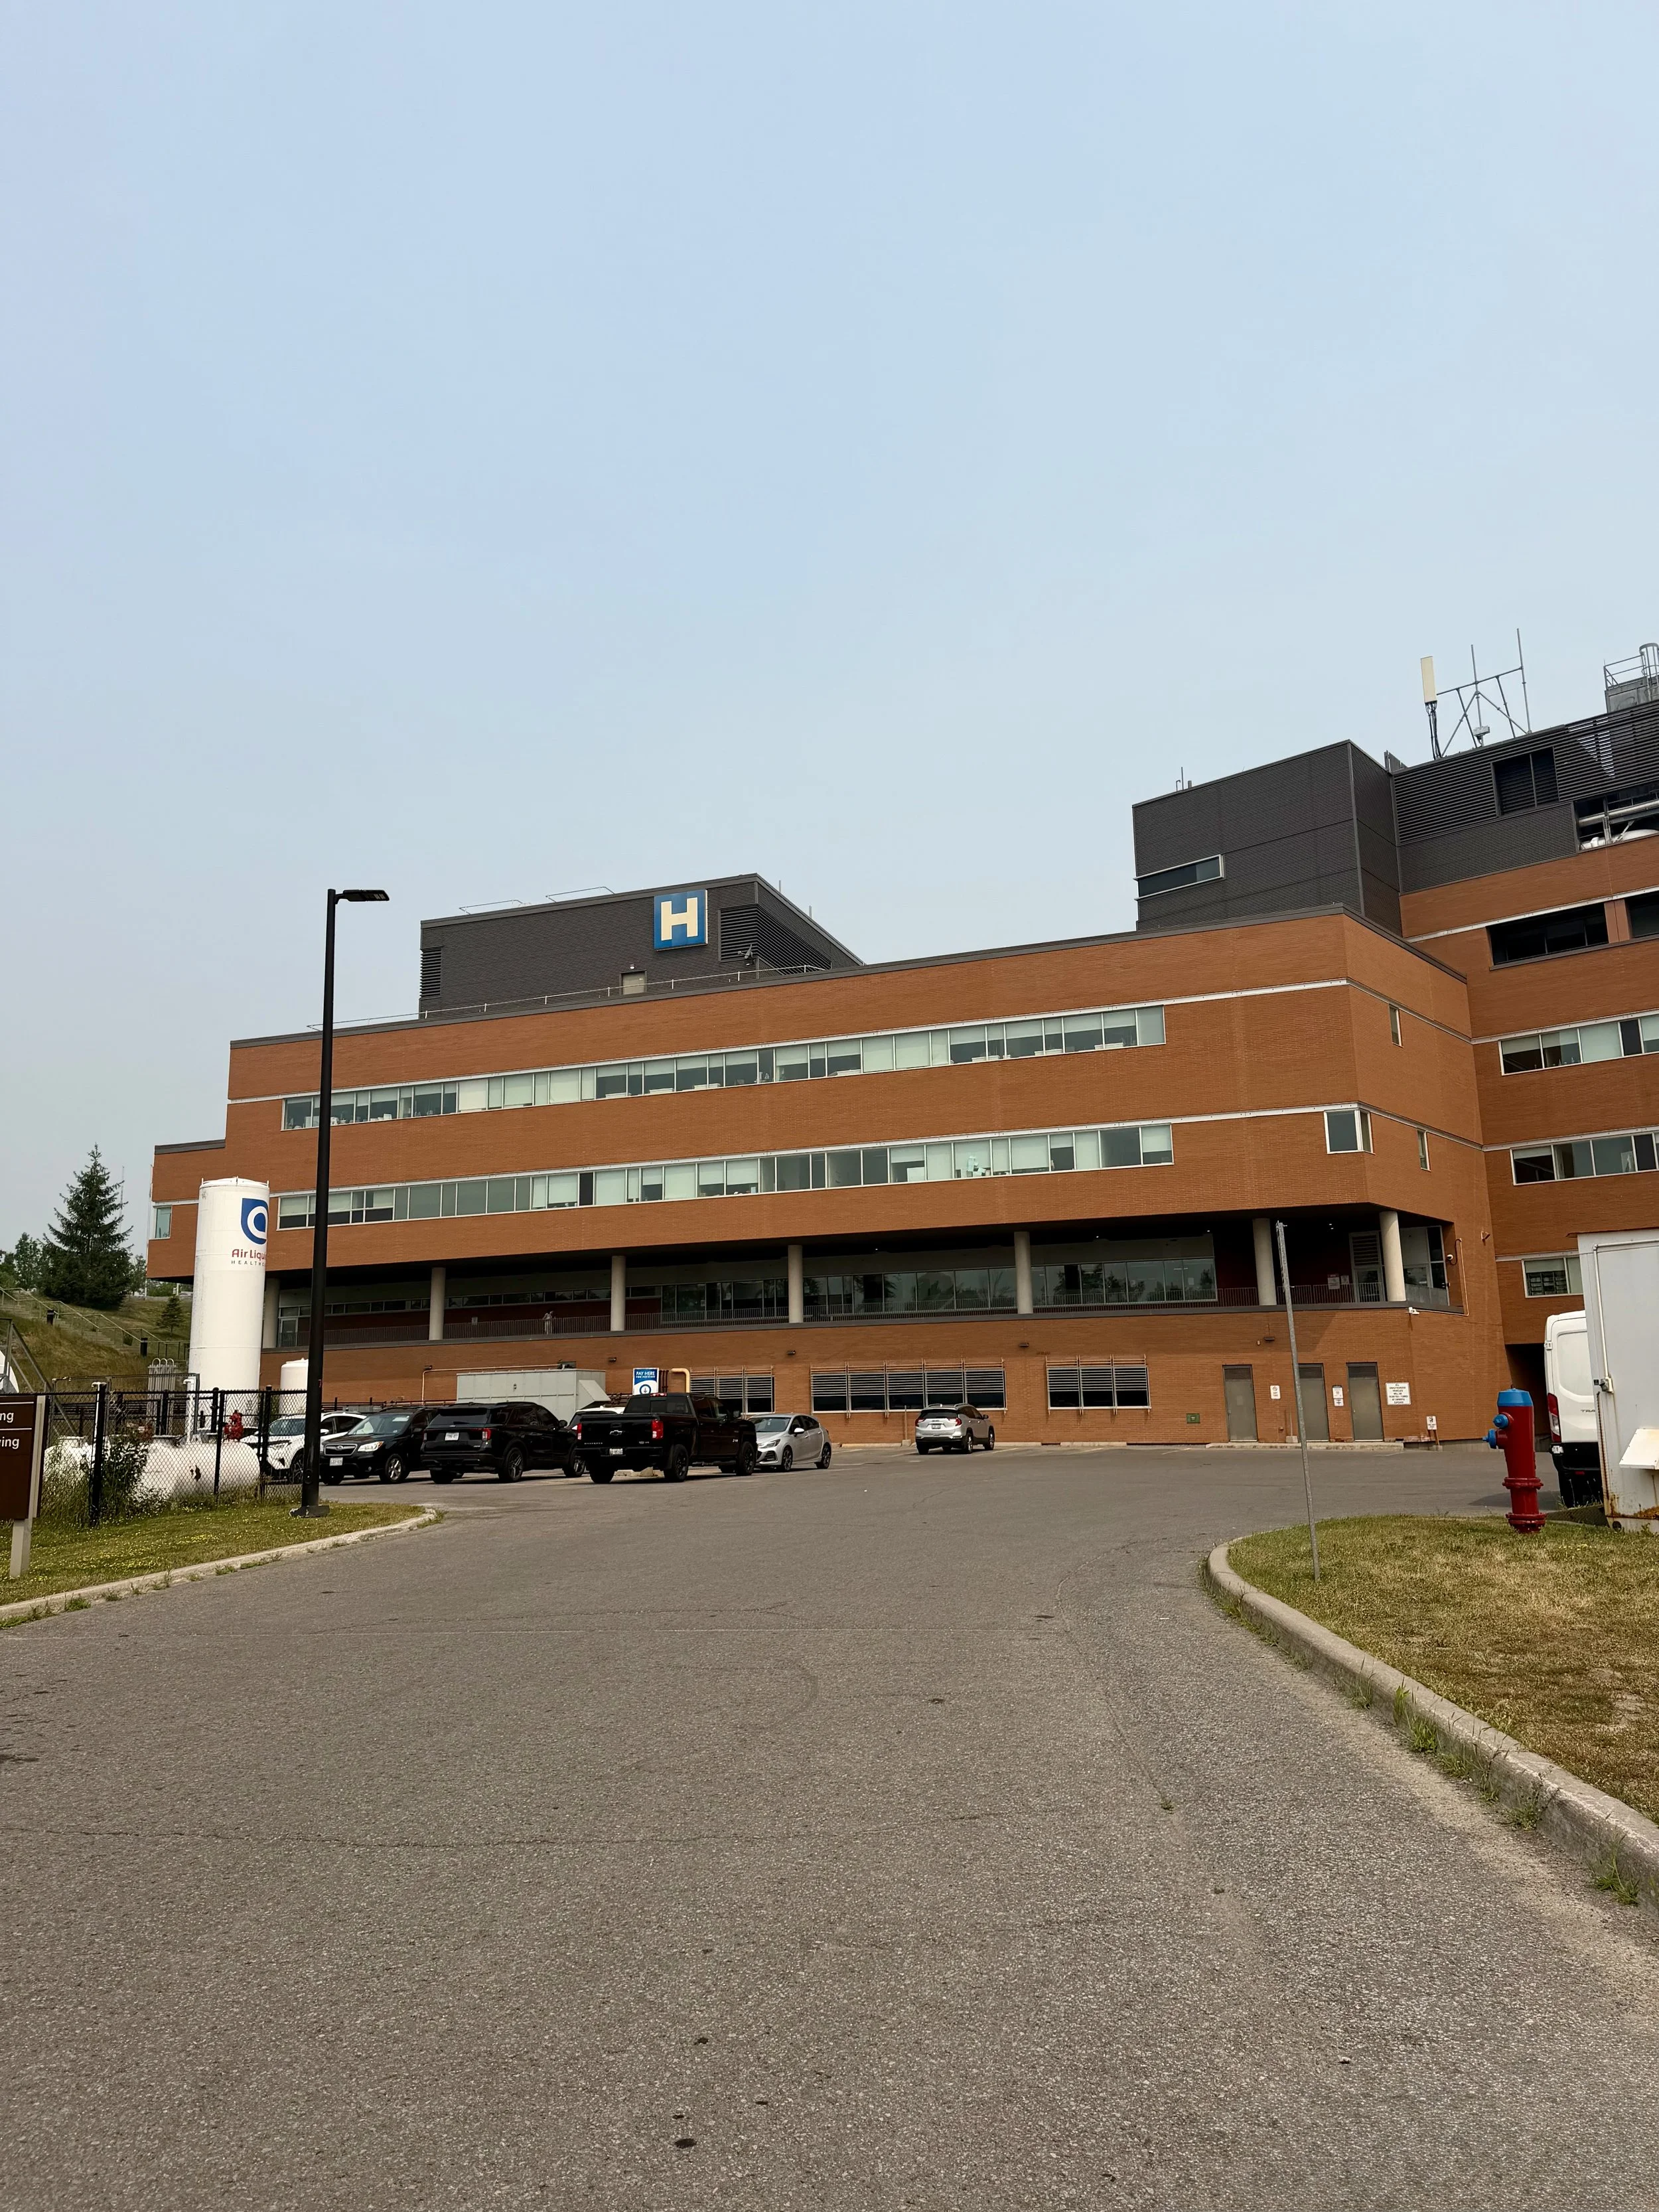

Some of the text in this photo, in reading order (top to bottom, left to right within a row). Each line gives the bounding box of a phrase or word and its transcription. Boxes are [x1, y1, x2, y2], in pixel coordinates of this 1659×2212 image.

[661, 897, 698, 941] H
[232, 1249, 248, 1258] Air
[0, 1436, 20, 1449] ing
